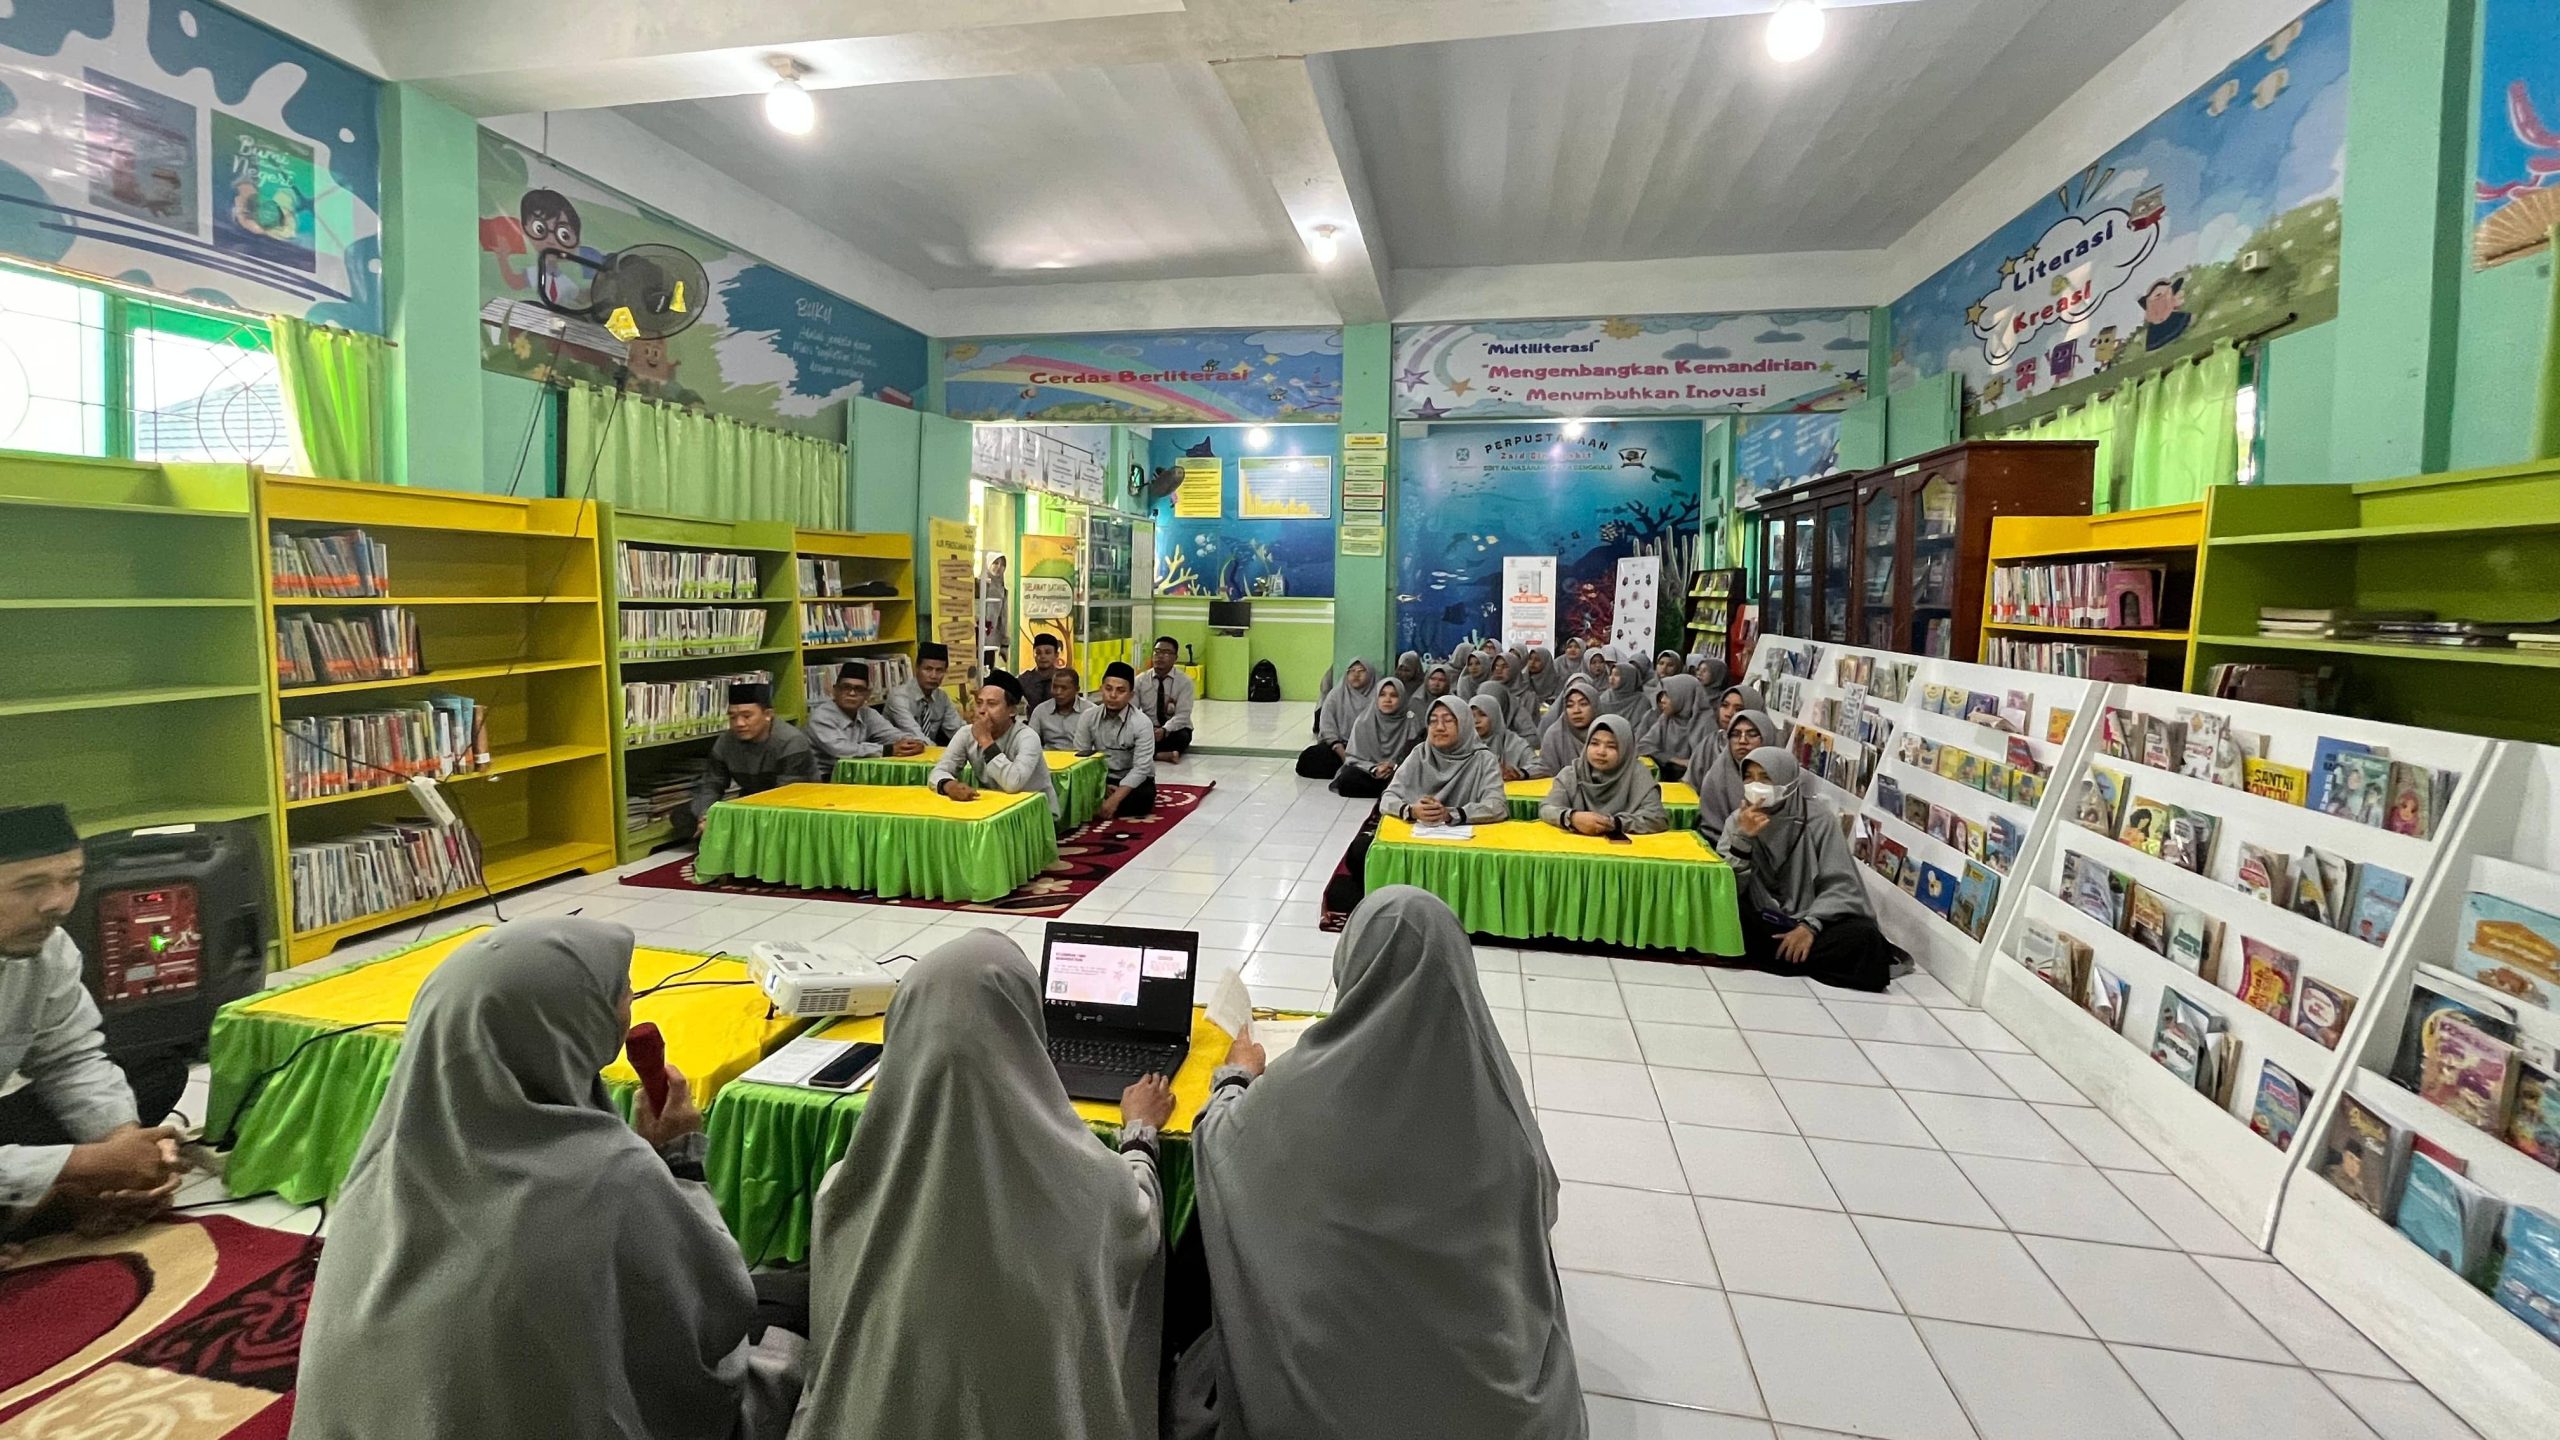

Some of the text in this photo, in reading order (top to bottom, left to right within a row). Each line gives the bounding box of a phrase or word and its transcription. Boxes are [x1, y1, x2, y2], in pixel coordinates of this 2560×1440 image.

[2013, 219, 2114, 292] Literasi
[2013, 279, 2092, 335] Kreasi
[1675, 358, 1818, 375] Kemandirian
[1029, 369, 1249, 385] Cerdas Berliterasi
[1526, 384, 1766, 401] Menumbuhkan Inovasi
[1484, 432, 1609, 454] PERPUSTAAAN
